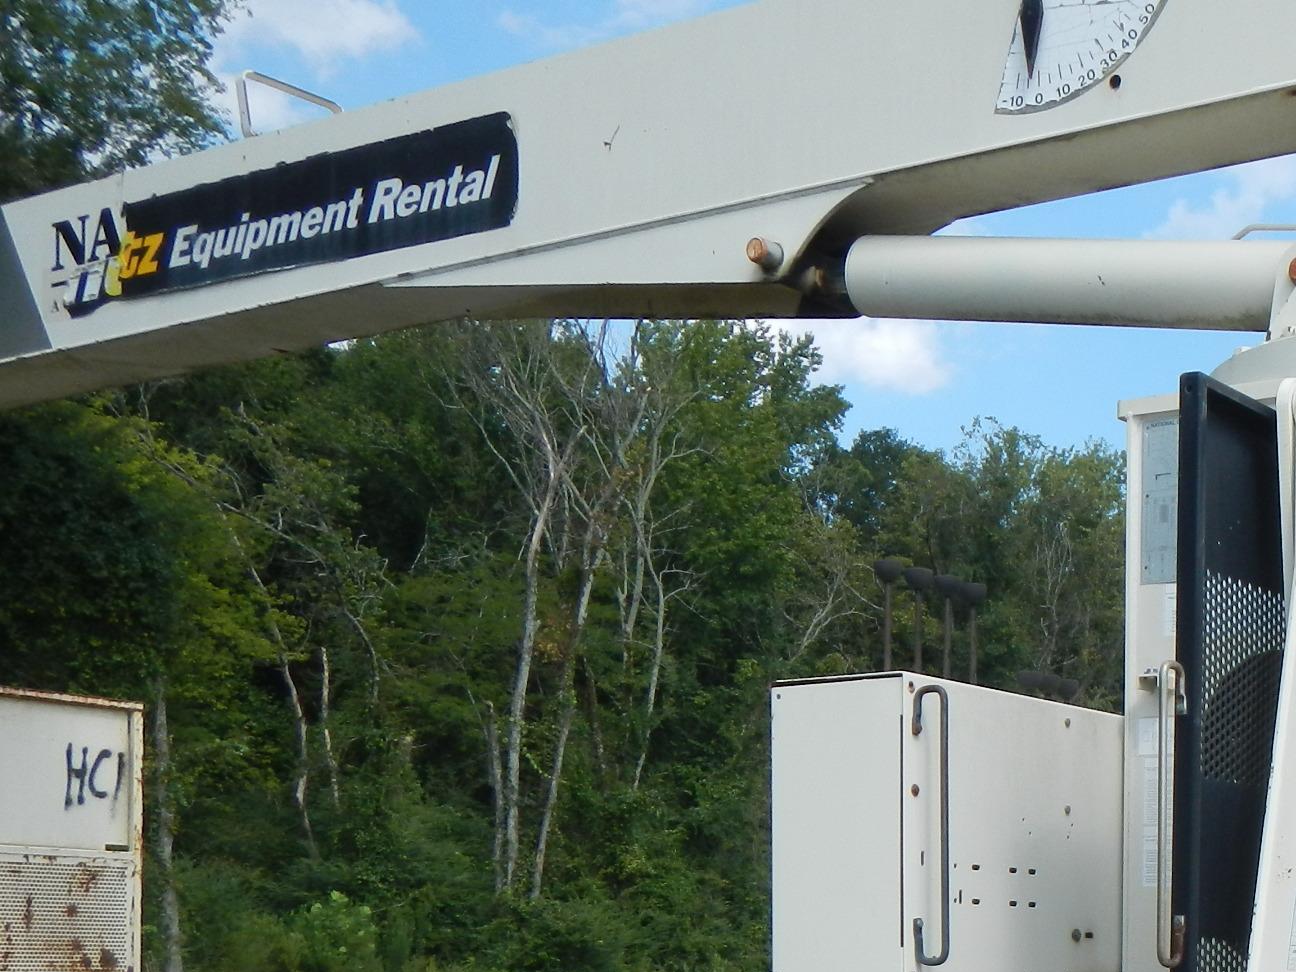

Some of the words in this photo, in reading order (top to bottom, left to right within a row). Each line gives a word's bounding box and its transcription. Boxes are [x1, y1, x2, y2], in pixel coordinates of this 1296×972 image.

[1121, 28, 1138, 49] 40
[1078, 68, 1096, 87] 20
[1034, 92, 1044, 105] 0
[1056, 83, 1071, 98] 10
[168, 187, 365, 269] Equipment
[368, 154, 501, 224] Rental
